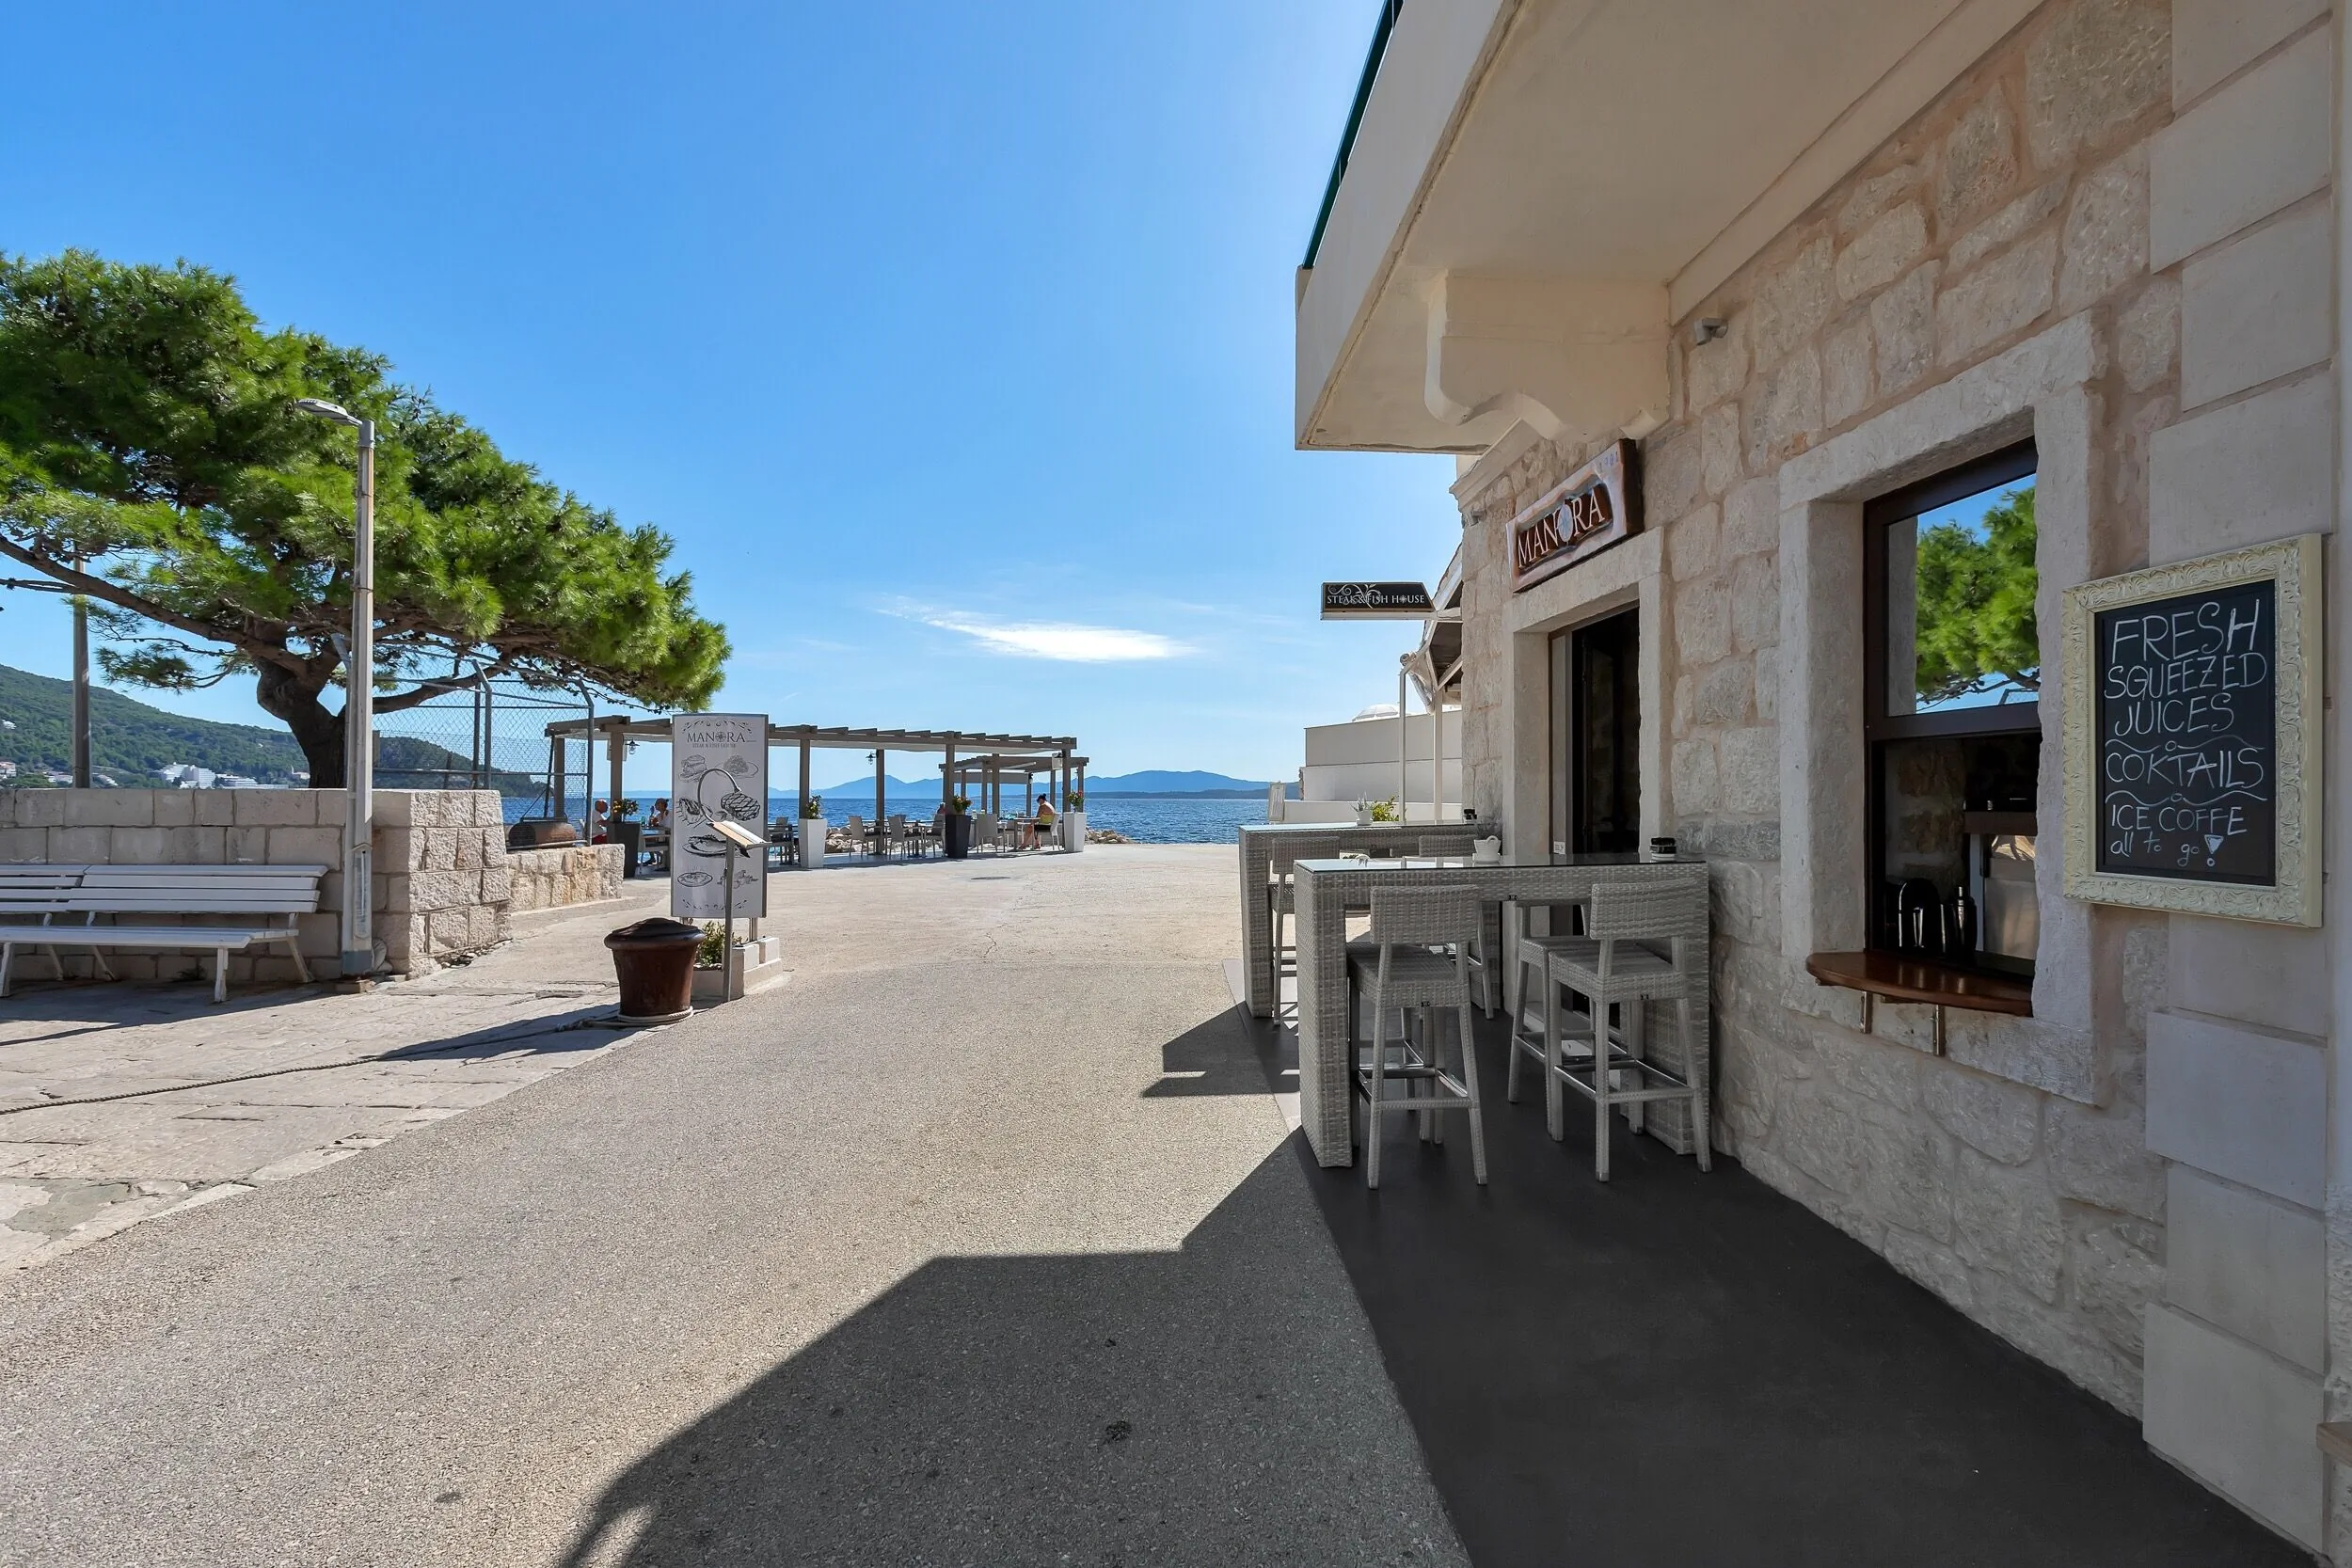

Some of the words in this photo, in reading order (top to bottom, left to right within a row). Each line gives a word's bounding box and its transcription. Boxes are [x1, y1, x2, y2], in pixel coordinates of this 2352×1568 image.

[1518, 487, 1605, 568] MANORA
[1392, 594, 1424, 604] HOUSE
[2112, 599, 2260, 663] FRESH
[2105, 652, 2267, 701] SQUEEZED
[2114, 692, 2234, 736] JUICES
[687, 732, 746, 743] MANORA
[2106, 748, 2265, 788] COKTAILS
[2111, 804, 2152, 831] ICE
[2158, 807, 2248, 835] COFFE
[2110, 832, 2134, 857] all
[2143, 832, 2162, 853] to
